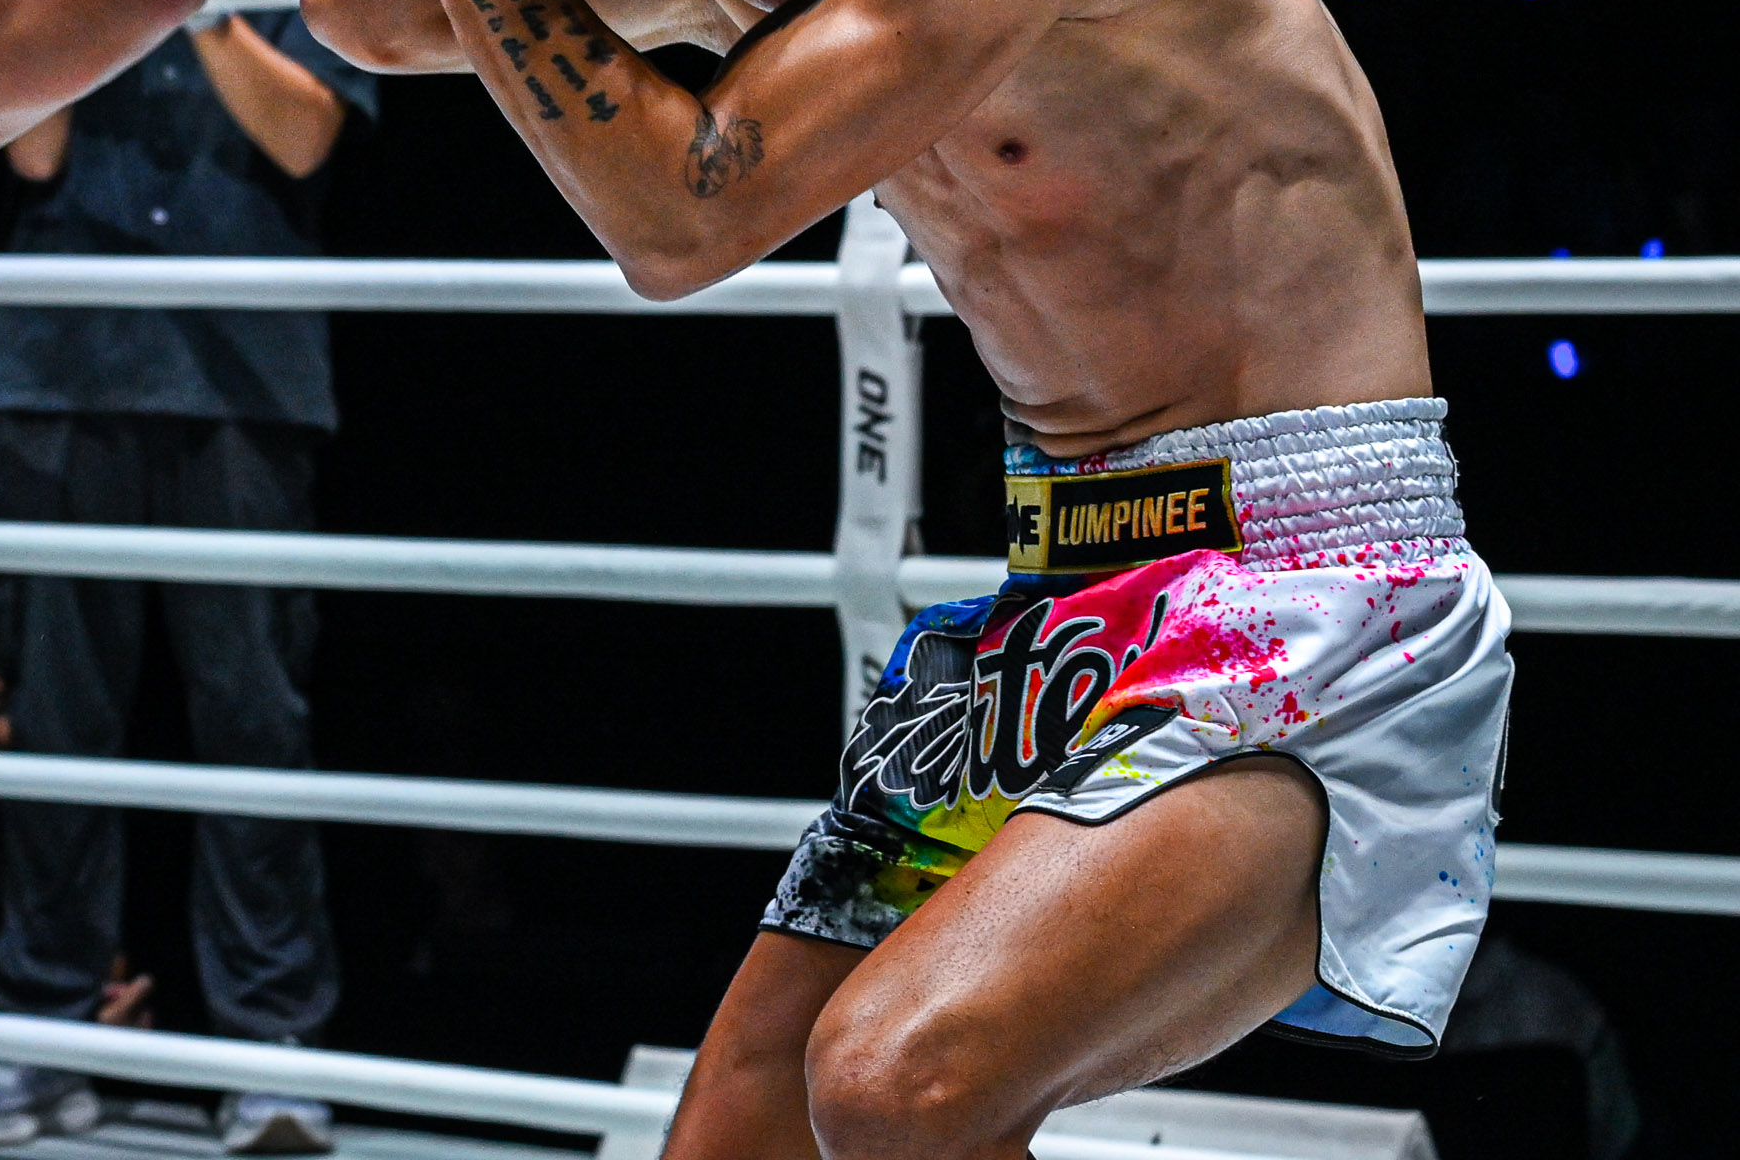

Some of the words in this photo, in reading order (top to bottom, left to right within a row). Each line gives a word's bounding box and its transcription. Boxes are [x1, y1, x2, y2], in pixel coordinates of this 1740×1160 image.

[853, 365, 894, 486] ONE
[1006, 494, 1040, 555] NE
[1058, 488, 1209, 546] LUMPINEE
